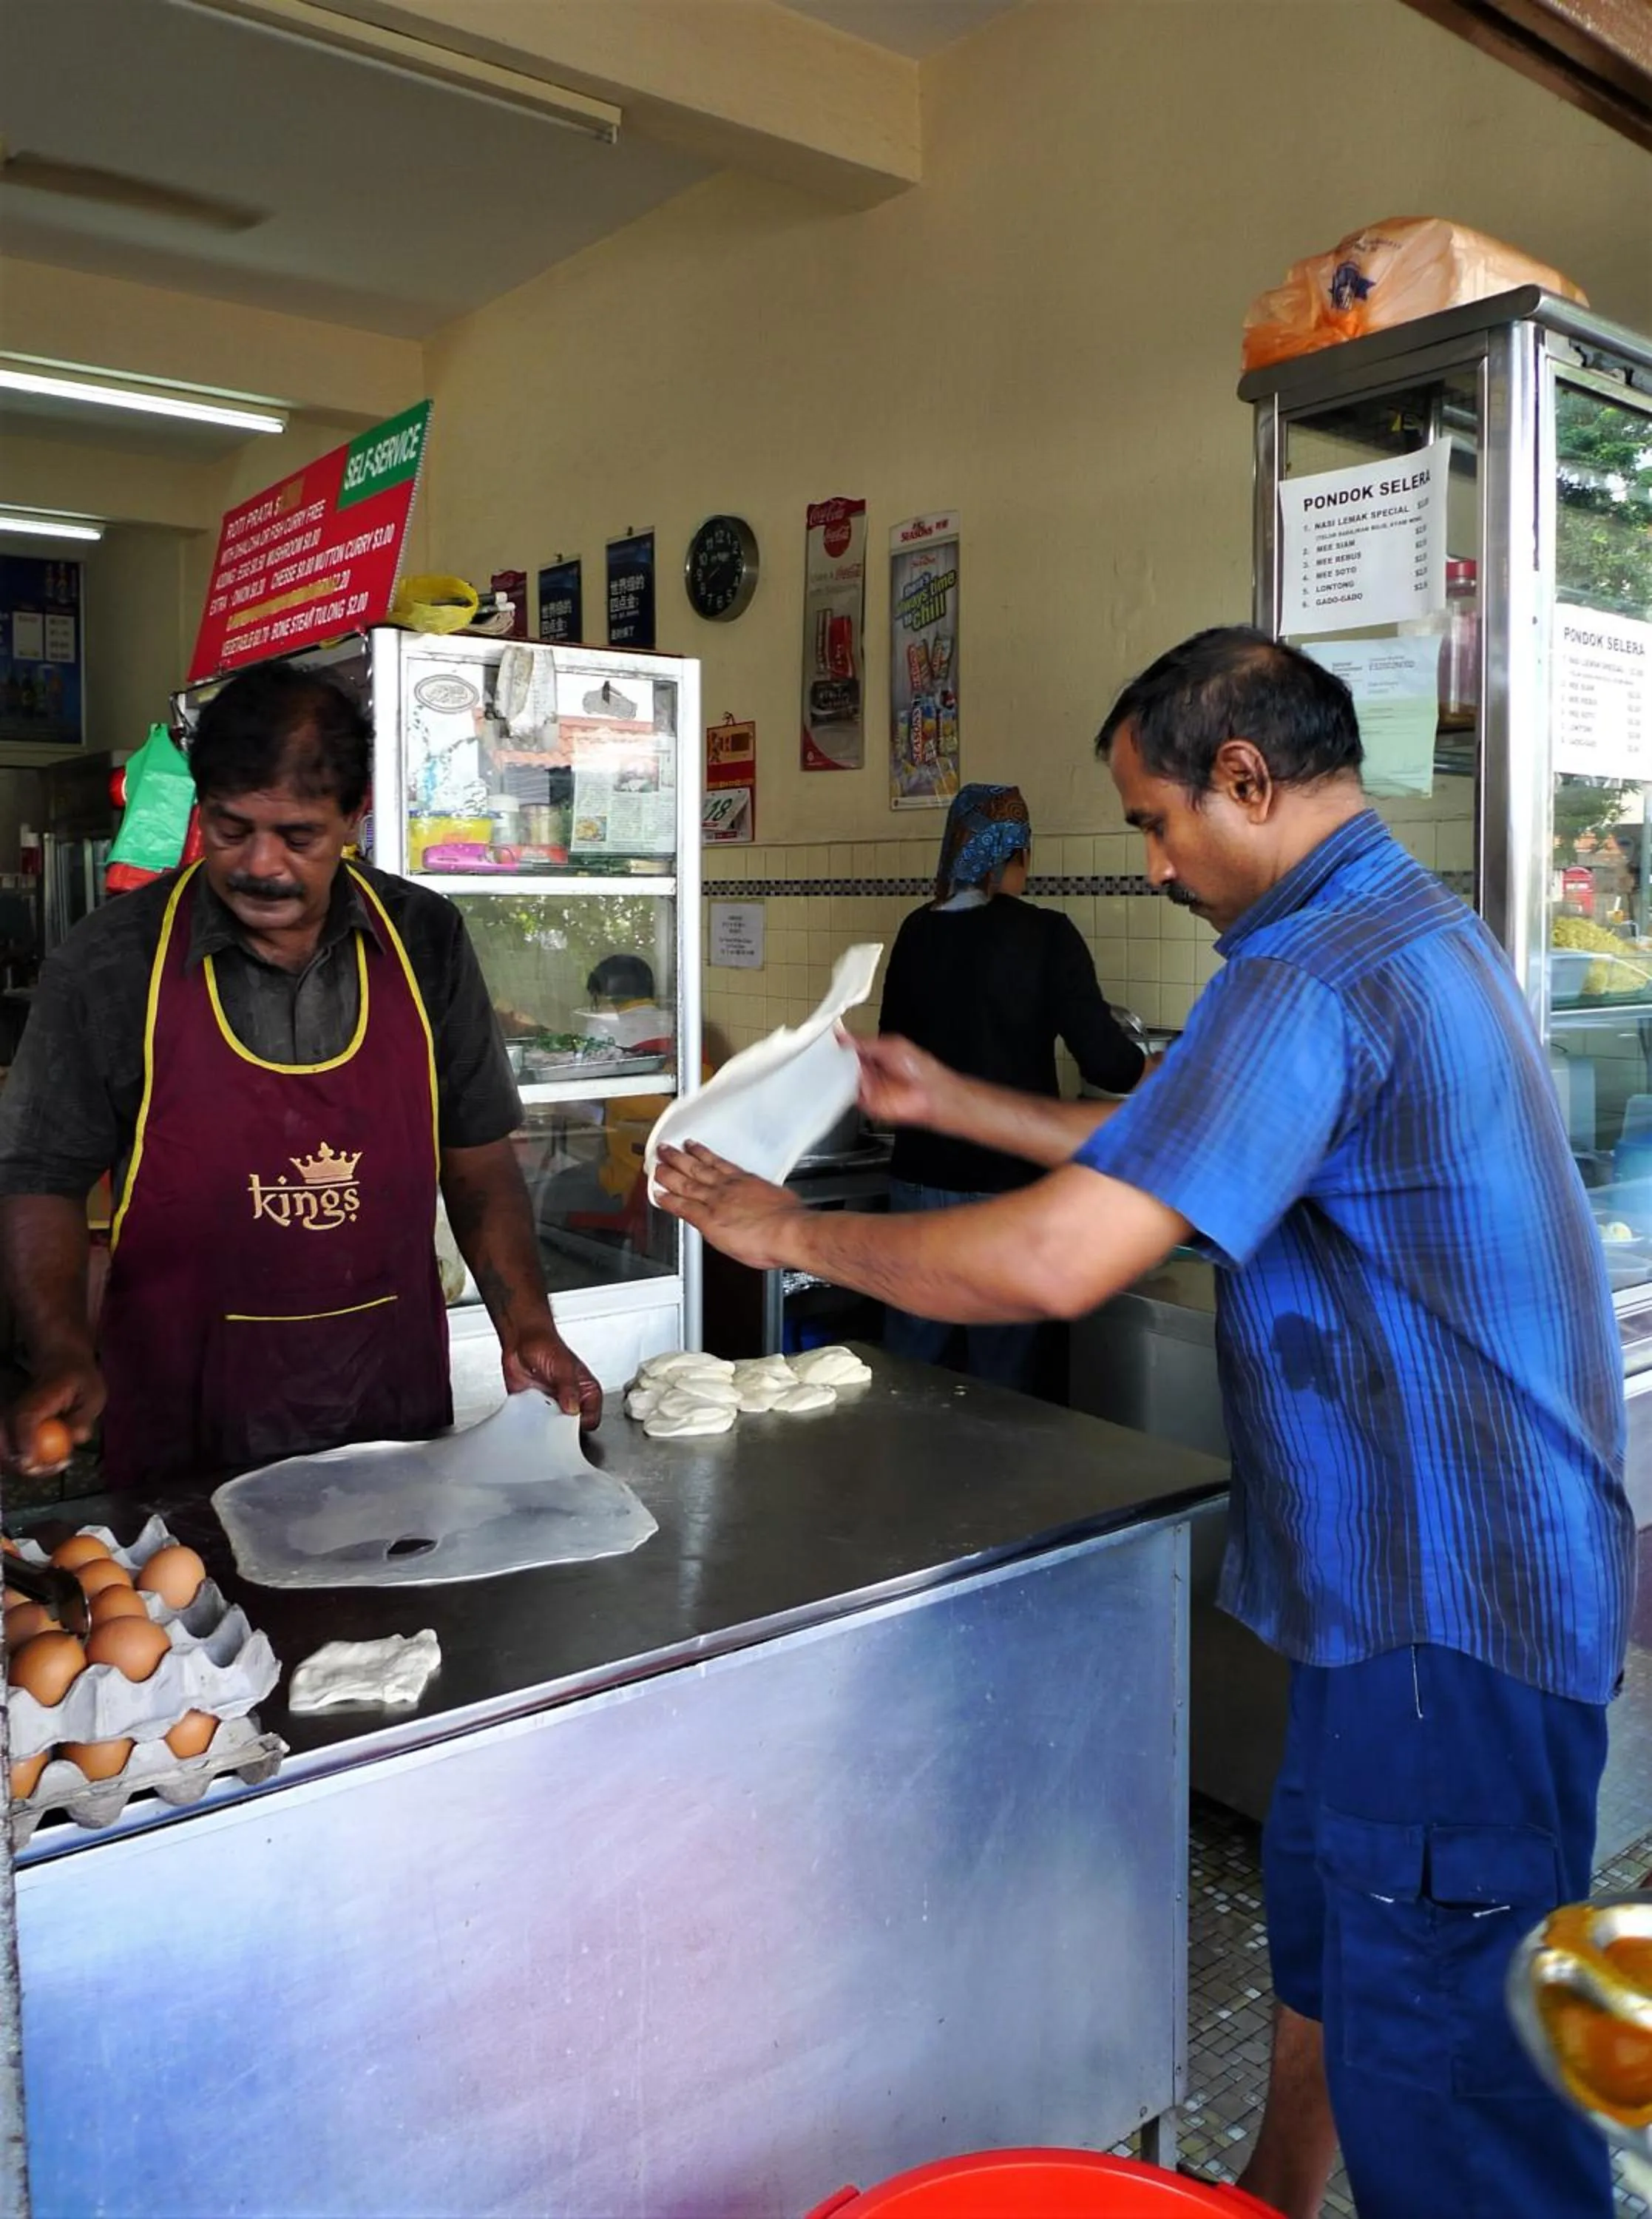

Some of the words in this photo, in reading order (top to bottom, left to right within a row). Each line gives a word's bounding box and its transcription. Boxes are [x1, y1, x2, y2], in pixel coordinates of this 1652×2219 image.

[344, 422, 422, 490] SELF-SERVICE
[1304, 485, 1374, 512] PONDOK
[1380, 470, 1431, 496] SELERA
[305, 498, 326, 524] FREE
[1315, 519, 1335, 530] NASI
[1338, 513, 1367, 525] LEMAK
[1370, 505, 1409, 519] SPECIAL
[715, 530, 725, 544] 12
[344, 531, 373, 559] CURRY
[732, 540, 739, 555] 2
[1317, 544, 1332, 552] MEE
[1336, 538, 1355, 549] SIAM
[699, 552, 708, 566] 10
[1316, 557, 1333, 565] MEE
[1336, 551, 1361, 562] REBUS
[697, 567, 703, 581] 9
[1336, 566, 1357, 576] SOTO
[931, 572, 954, 595] time
[1316, 580, 1354, 592] LONTONG
[707, 592, 713, 607] 7
[717, 595, 723, 609] 6
[1316, 592, 1362, 605] GADO-GADO
[913, 592, 944, 629] chill
[1564, 627, 1603, 649] PONDOK
[1608, 637, 1645, 655] SELERA
[703, 797, 733, 822] 18
[249, 1174, 361, 1230] kings
